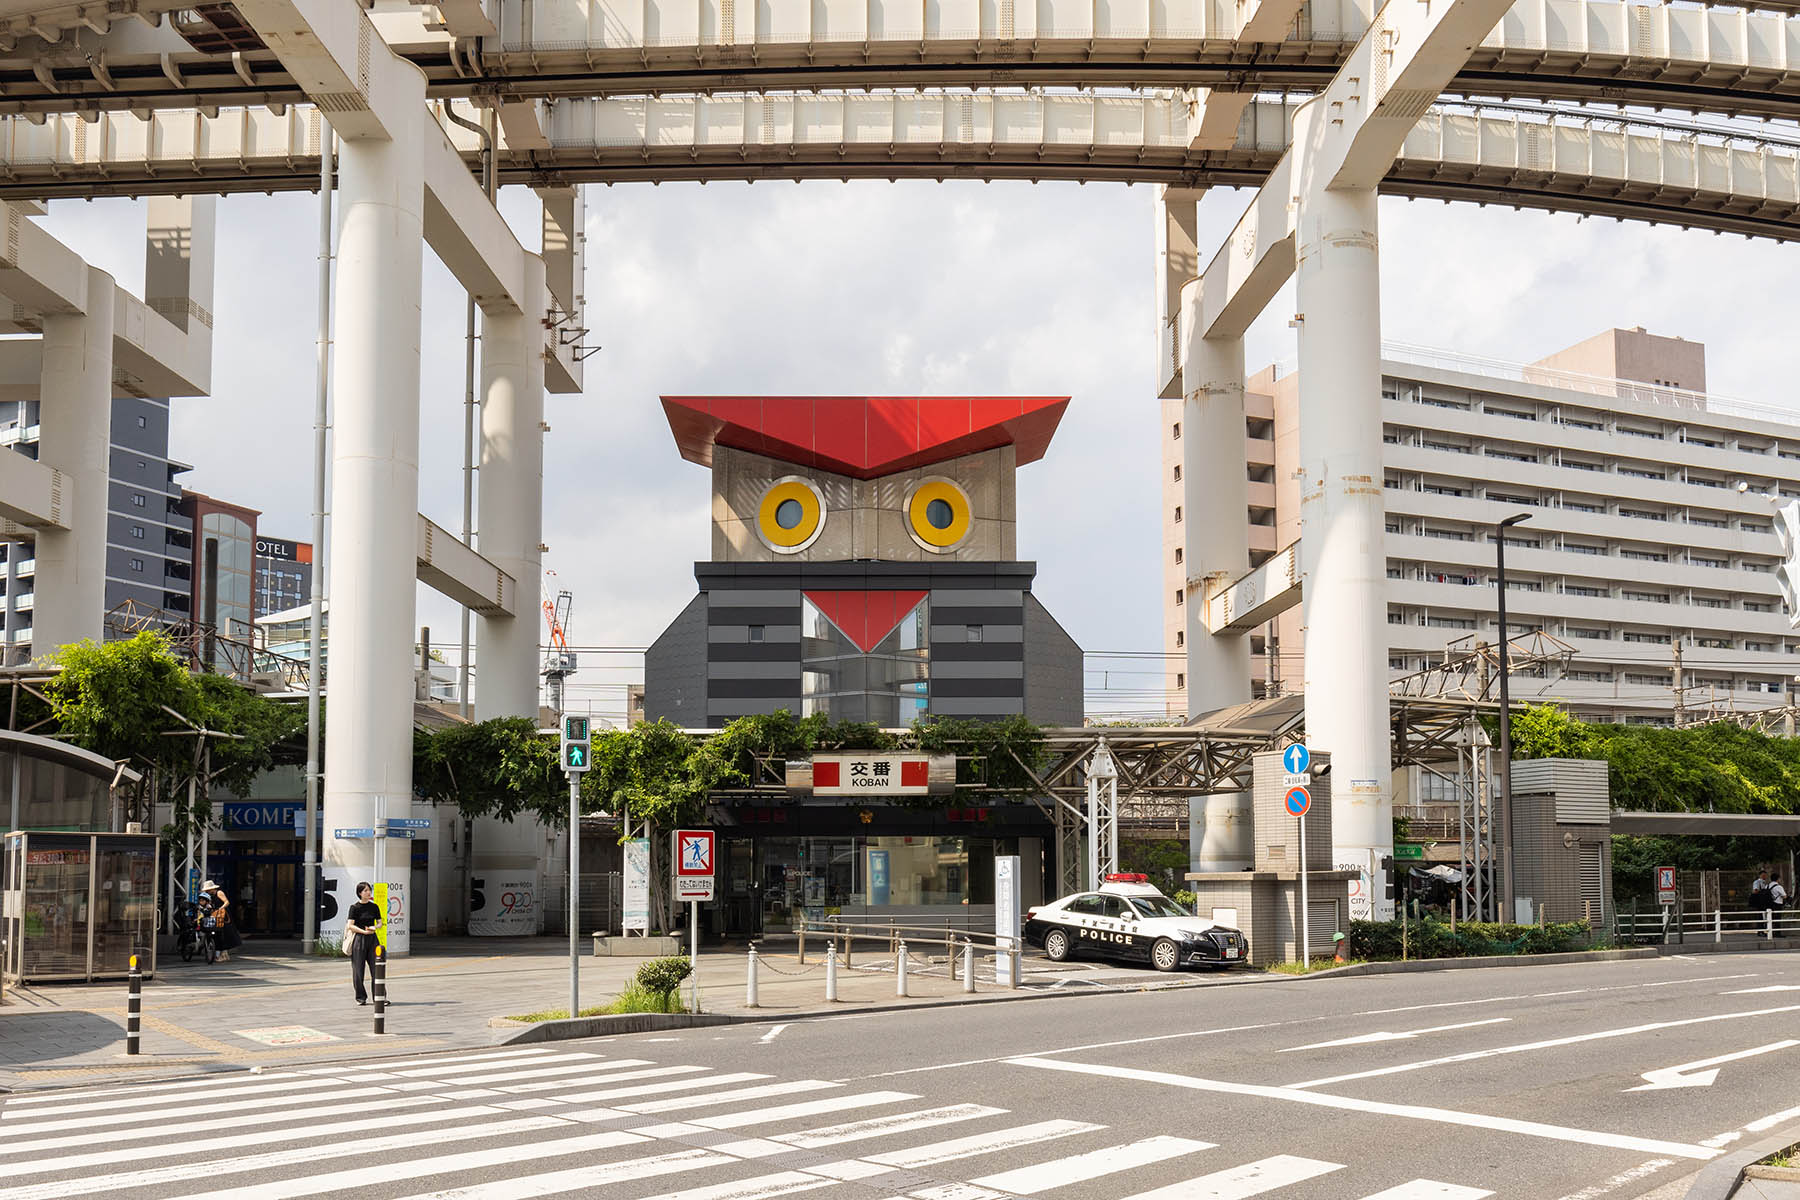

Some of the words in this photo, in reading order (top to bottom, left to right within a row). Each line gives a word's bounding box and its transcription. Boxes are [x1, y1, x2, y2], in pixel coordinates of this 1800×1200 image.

[256, 541, 288, 556] OTEL
[850, 761, 891, 777] 交番
[852, 778, 889, 787] KOBAN
[229, 807, 294, 825] KOME
[1080, 928, 1133, 945] POLICE
